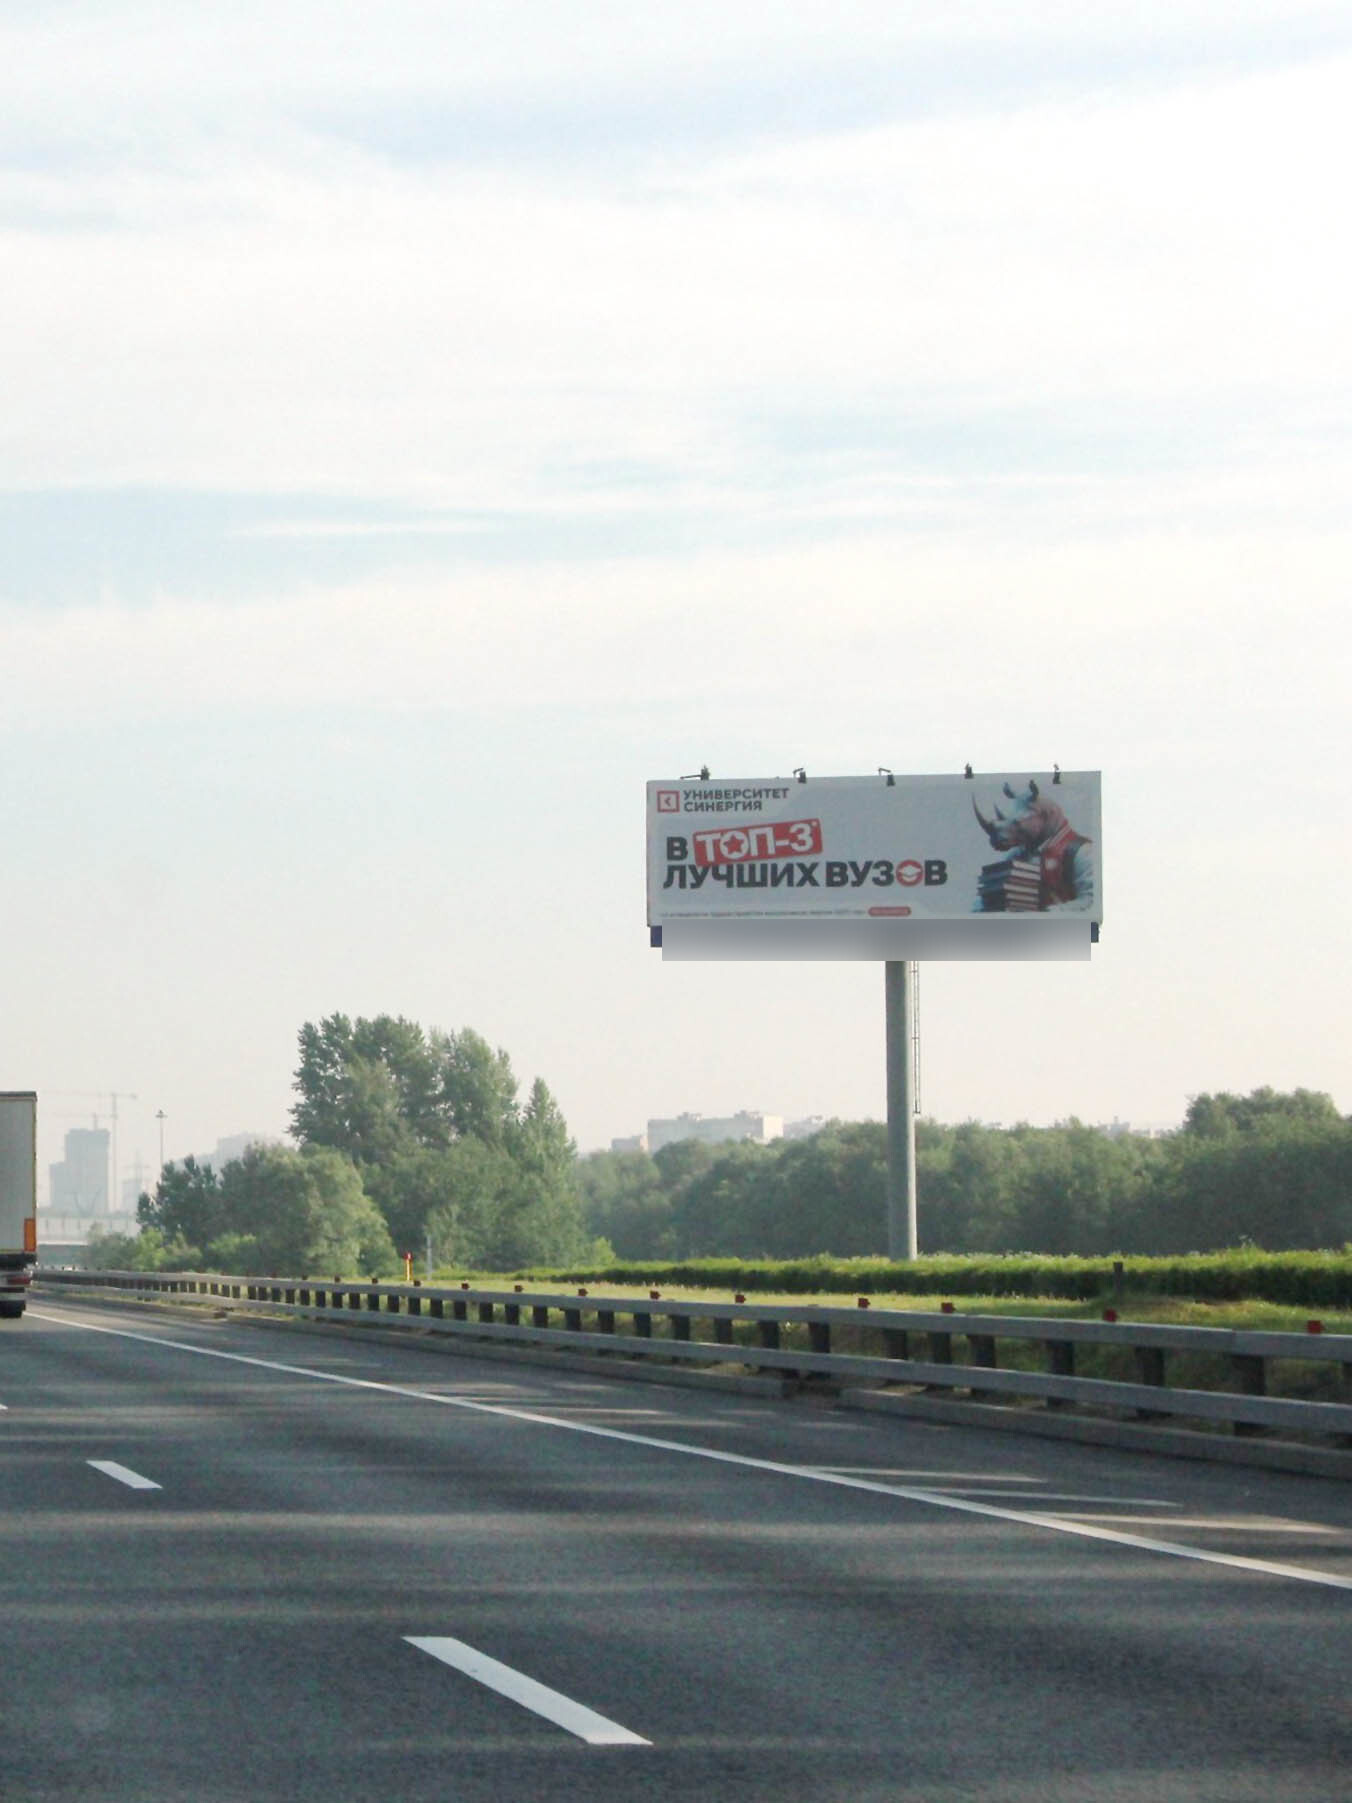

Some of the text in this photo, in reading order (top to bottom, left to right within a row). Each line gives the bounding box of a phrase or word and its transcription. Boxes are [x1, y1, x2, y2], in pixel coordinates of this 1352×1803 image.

[683, 787, 790, 801] УНИВЕРСИТЕТ
[683, 801, 763, 812] СИНЕРГИЯ
[667, 836, 688, 861] В
[662, 859, 948, 889] ЛУЧШИХ ВУЗОВ
